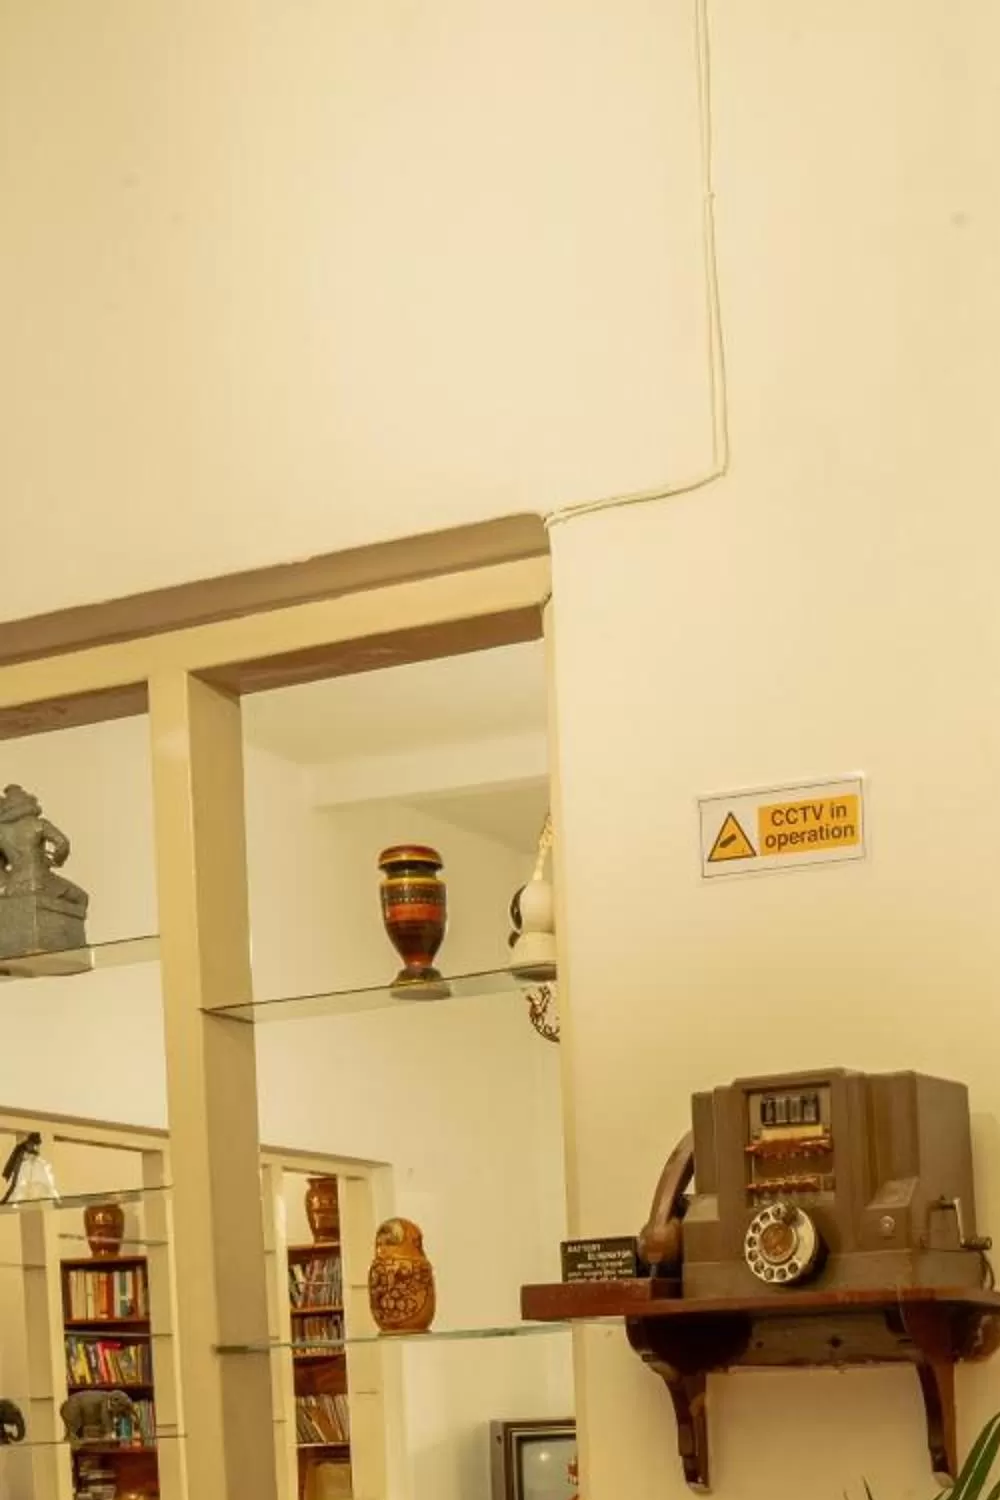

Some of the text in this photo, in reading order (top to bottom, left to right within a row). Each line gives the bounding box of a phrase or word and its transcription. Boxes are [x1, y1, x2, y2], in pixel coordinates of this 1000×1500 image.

[771, 802, 847, 826] CCTV in
[765, 823, 855, 851] operation
